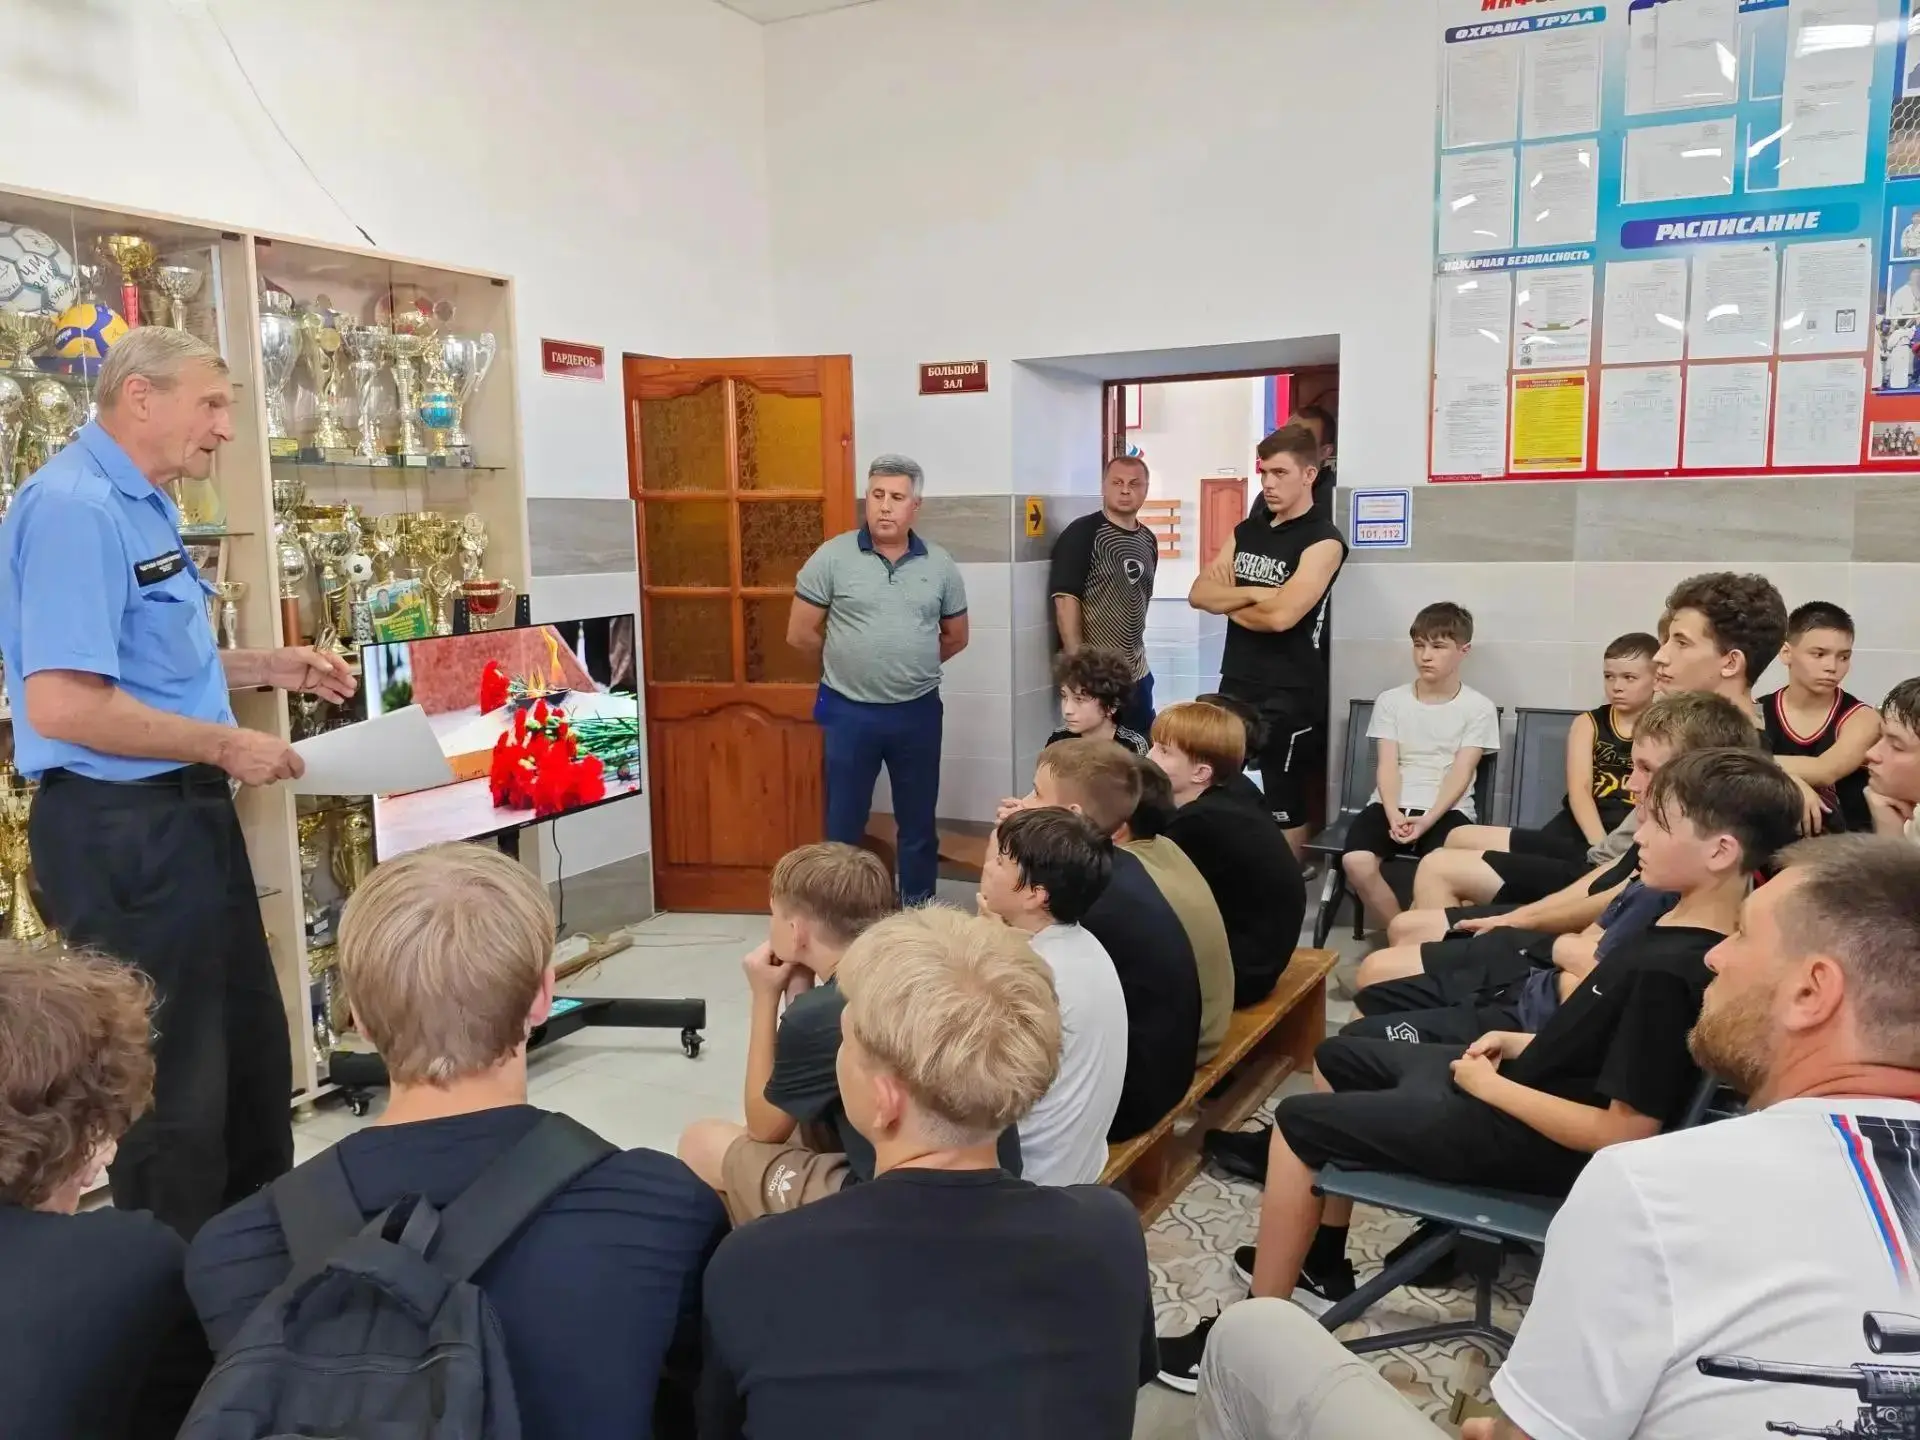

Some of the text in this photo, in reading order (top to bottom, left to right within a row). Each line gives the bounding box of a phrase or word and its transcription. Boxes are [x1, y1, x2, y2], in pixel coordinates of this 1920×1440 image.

[1455, 10, 1595, 40] ОХРАНА ТРУДА
[1655, 211, 1821, 241] РАСПИСАНИЕ
[1507, 249, 1590, 266] БЕЗОПАСНОСТЬ
[551, 351, 596, 368] ГАРДЕРОБ
[927, 362, 979, 377] БОЛЬШОЙ
[943, 379, 963, 389] ЗАЛ
